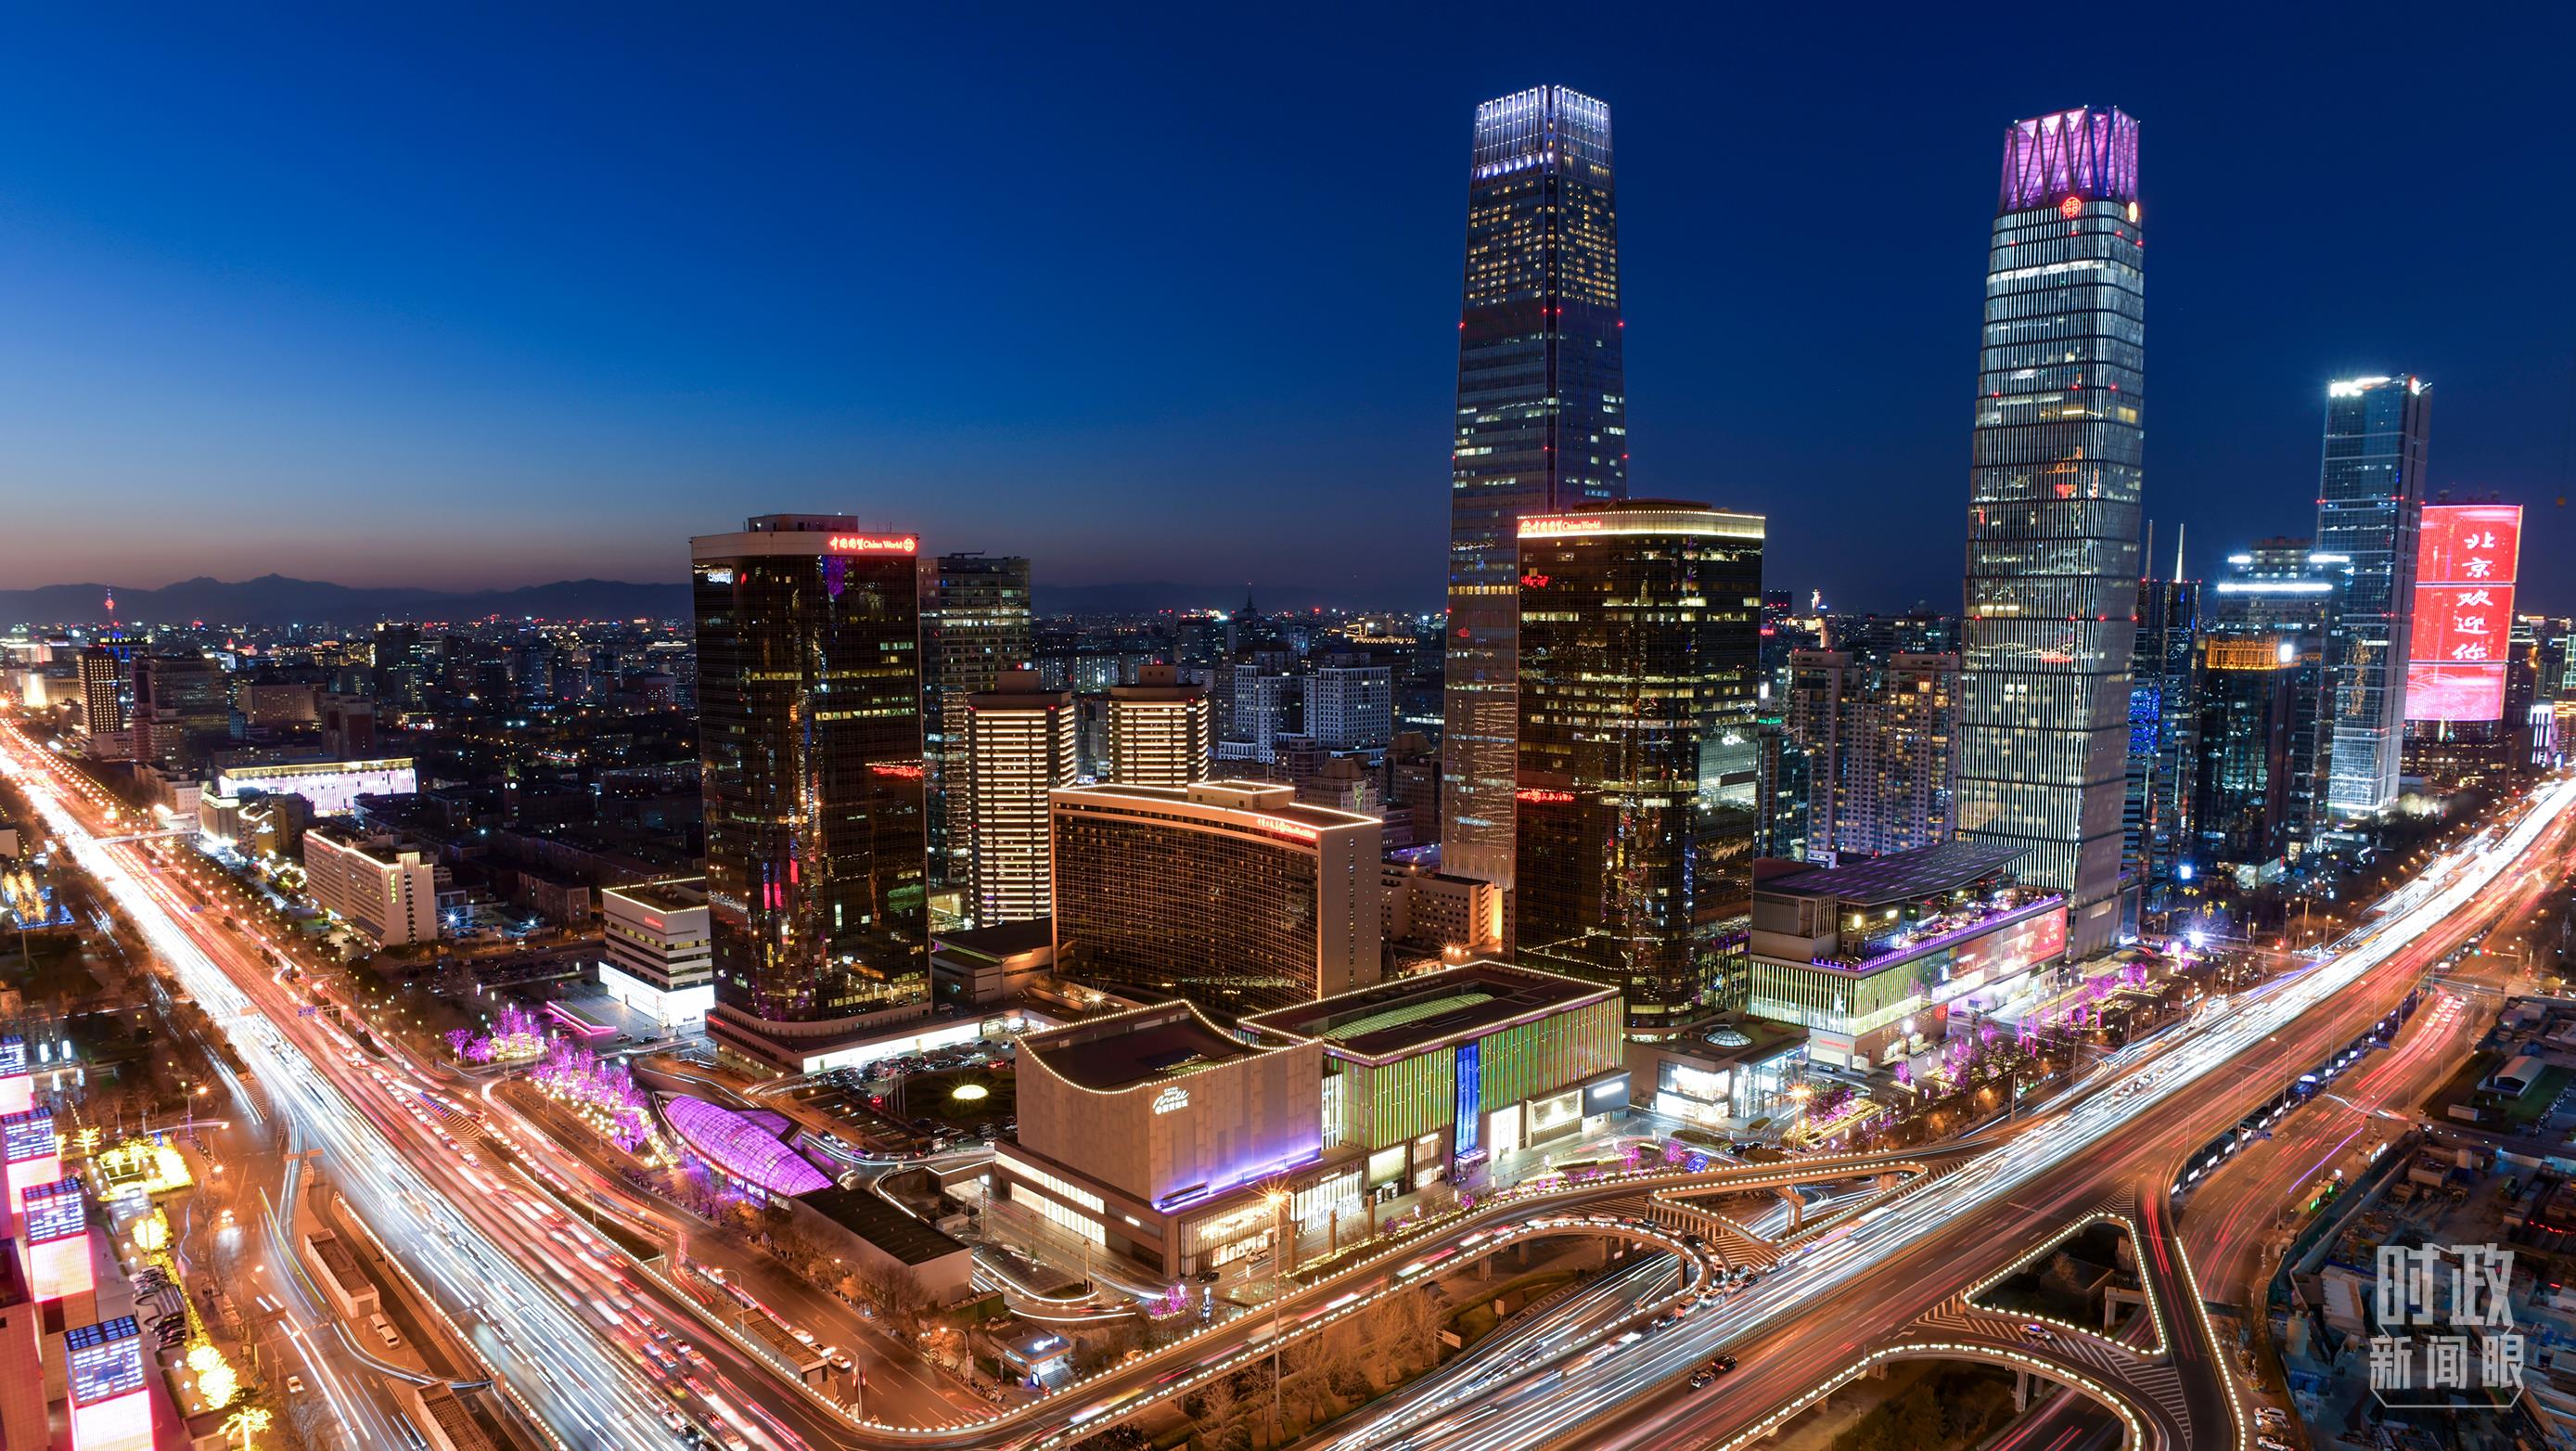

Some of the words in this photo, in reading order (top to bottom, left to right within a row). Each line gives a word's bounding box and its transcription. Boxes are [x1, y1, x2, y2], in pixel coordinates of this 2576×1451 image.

[1562, 520, 1582, 532] China
[1582, 520, 1601, 530] World
[863, 540, 883, 549] China
[882, 540, 903, 549] World
[2451, 531, 2496, 661] 北京欢迎你
